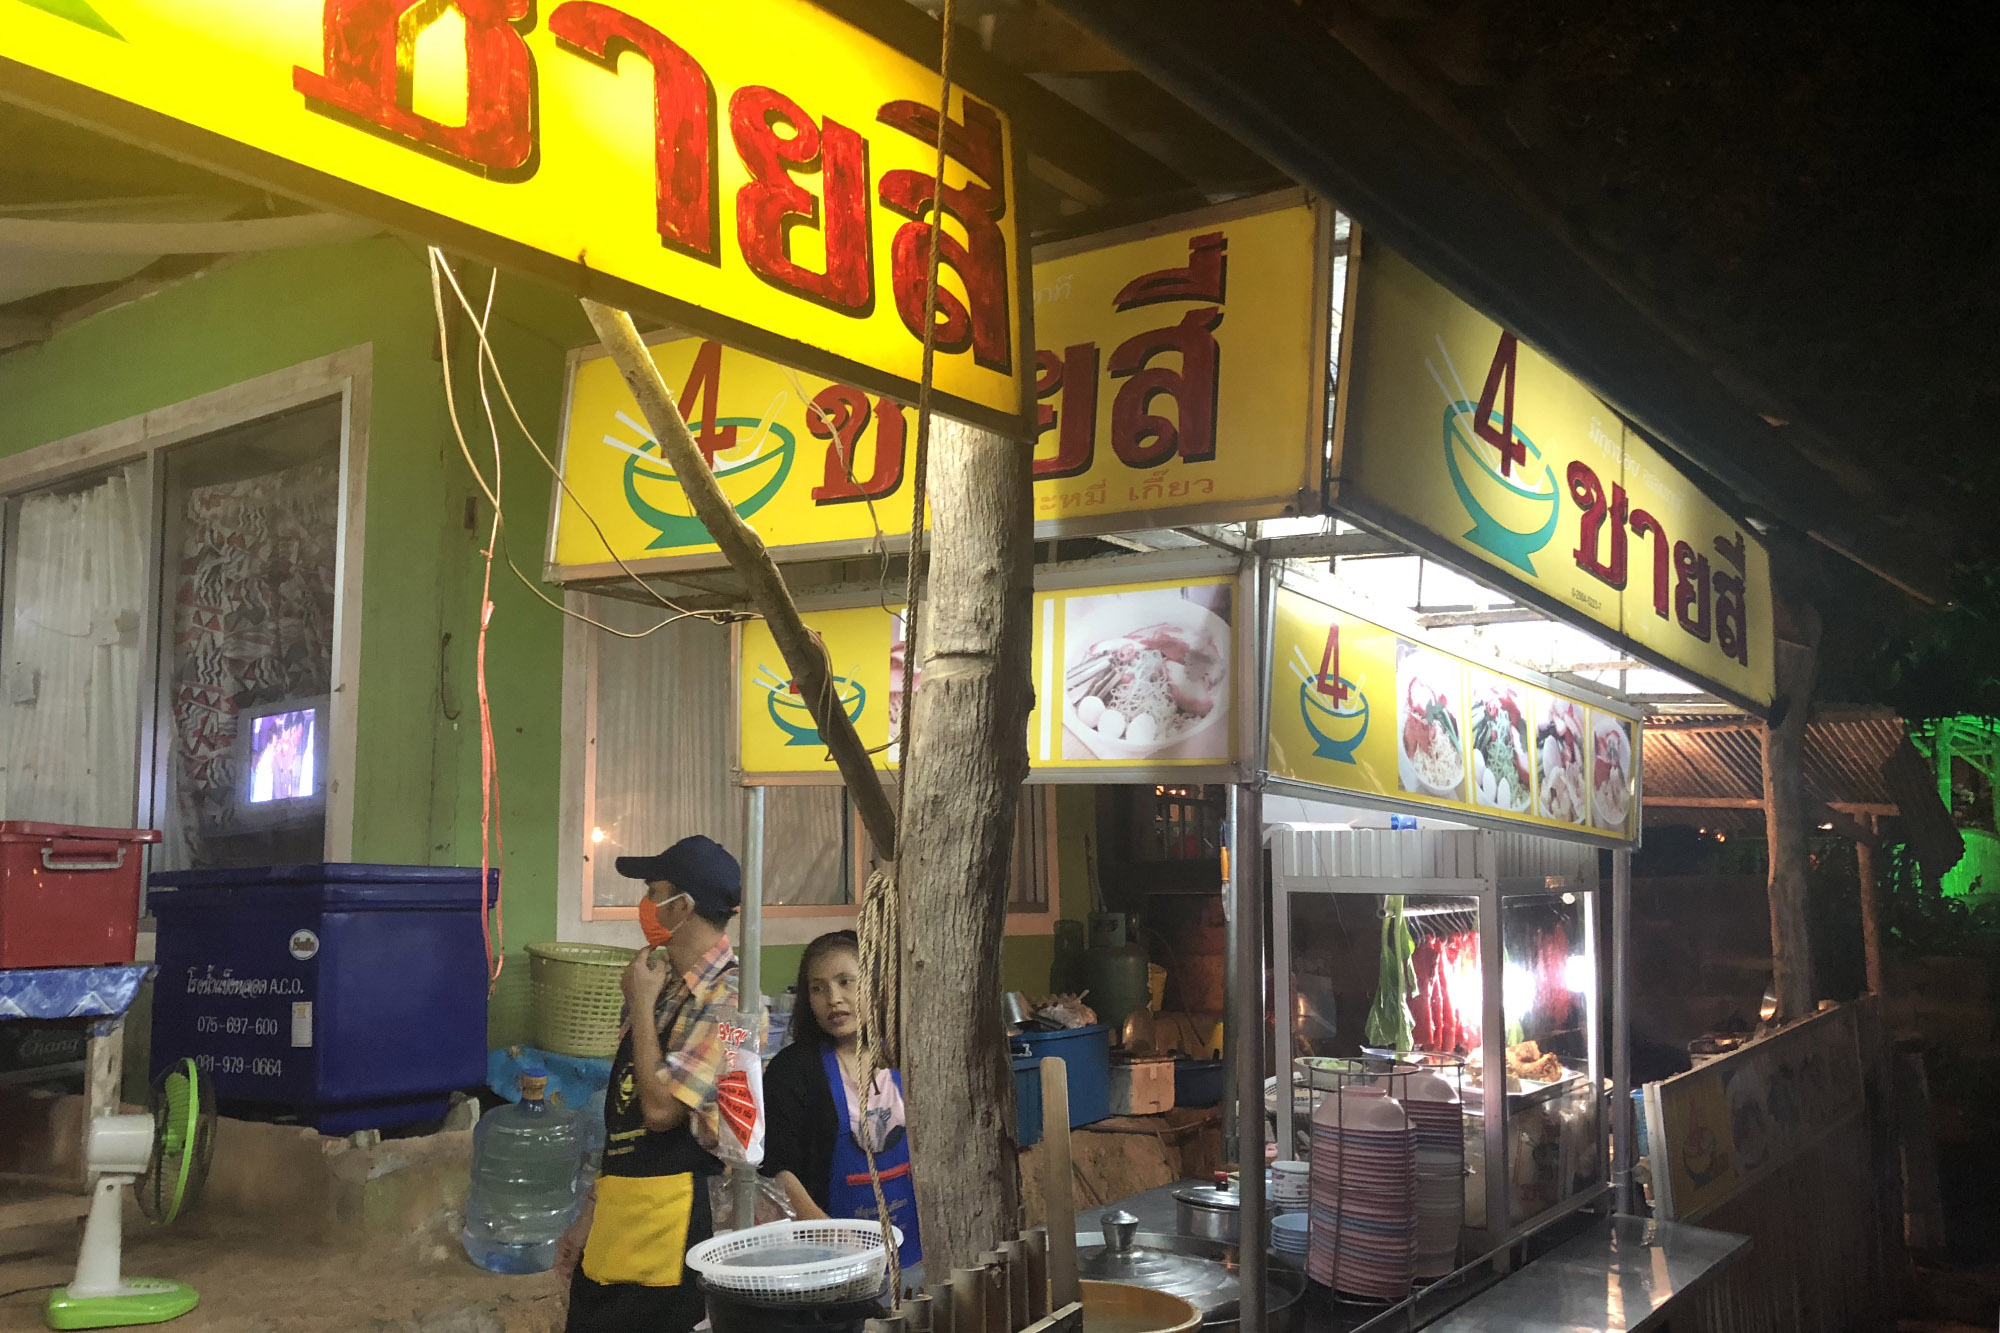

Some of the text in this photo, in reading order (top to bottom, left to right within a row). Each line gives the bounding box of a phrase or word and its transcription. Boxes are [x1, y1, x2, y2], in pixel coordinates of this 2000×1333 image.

[1474, 329, 1526, 478] 4
[1316, 622, 1348, 710] 4
[197, 1015, 278, 1035] 075-697-600
